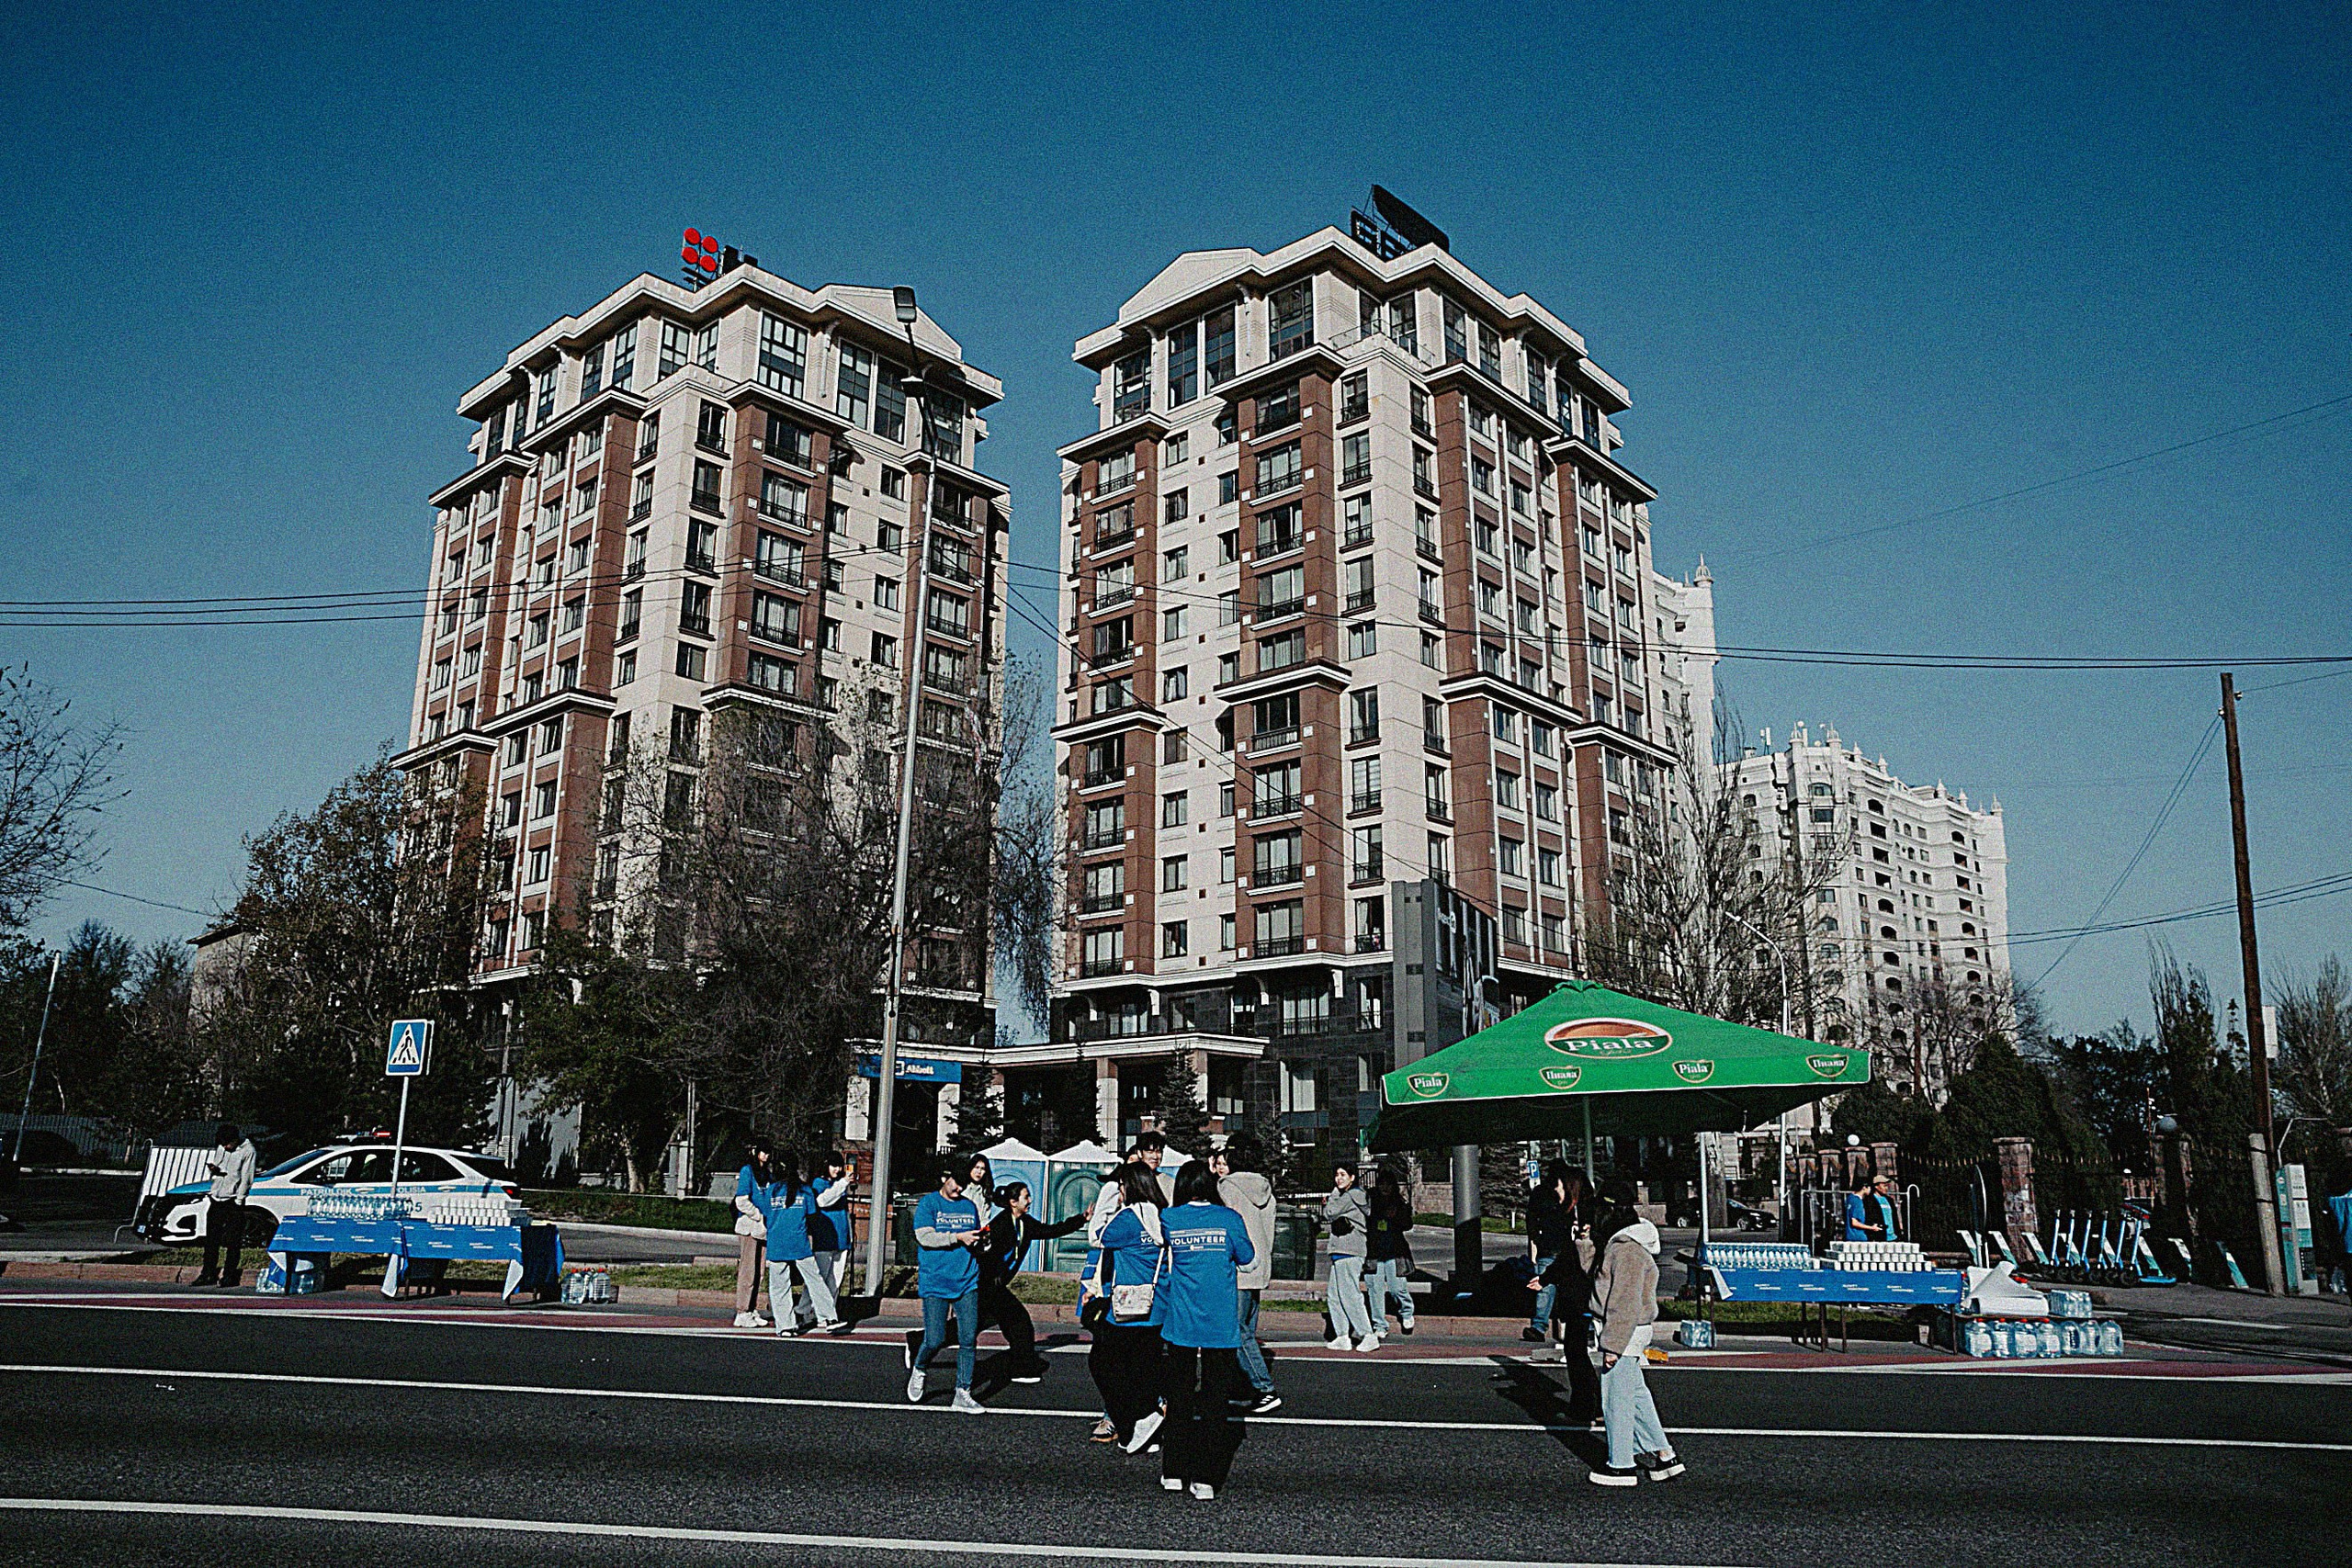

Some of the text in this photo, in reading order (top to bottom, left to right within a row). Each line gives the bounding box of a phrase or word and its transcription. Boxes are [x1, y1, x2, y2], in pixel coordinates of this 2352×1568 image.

[1565, 1038, 1655, 1051] Piala
[1679, 1063, 1708, 1074] Piala
[1546, 1070, 1577, 1079] Пиала
[1413, 1077, 1442, 1089] Piala
[1531, 1163, 1537, 1178] P
[396, 1186, 426, 1194] OLISIA
[1170, 1235, 1226, 1246] VOLUNTEER
